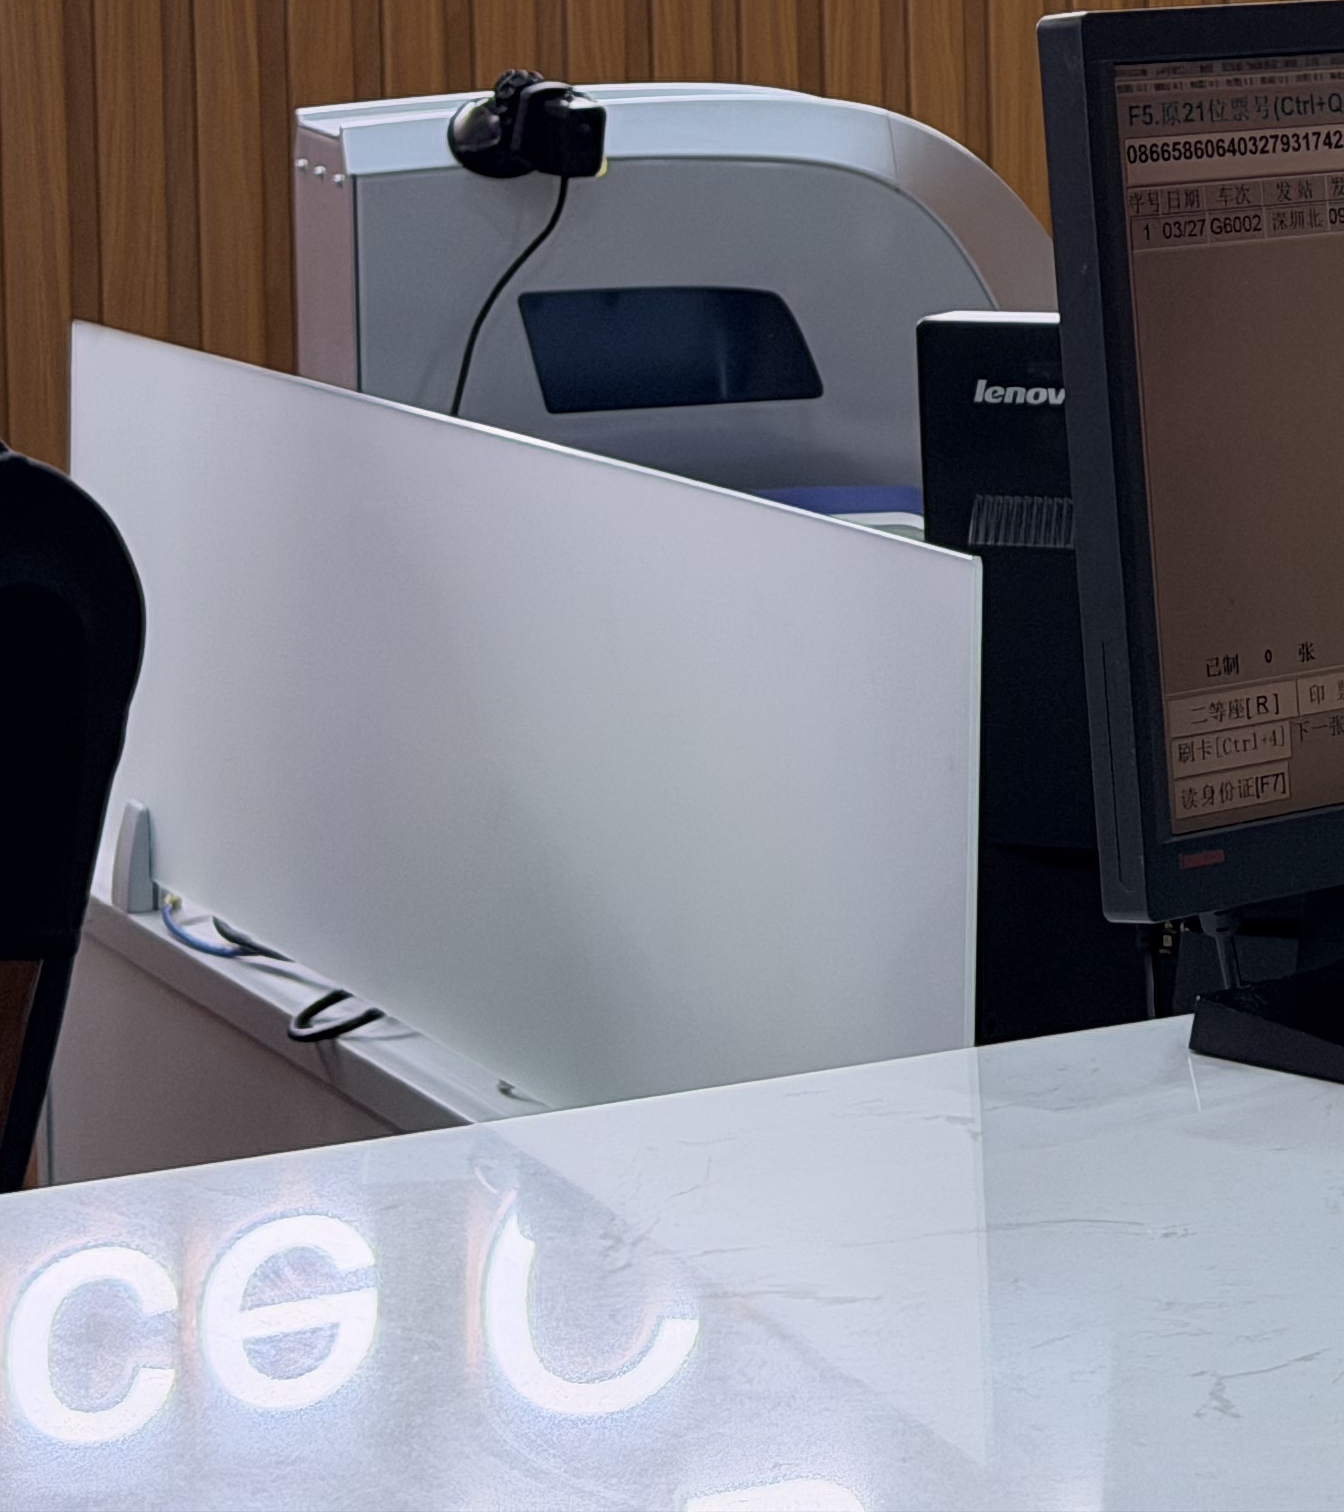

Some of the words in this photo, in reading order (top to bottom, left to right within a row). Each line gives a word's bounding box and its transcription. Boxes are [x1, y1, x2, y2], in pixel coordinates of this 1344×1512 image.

[1143, 224, 1151, 241] 1
[1162, 218, 1206, 240] 03/27
[1209, 214, 1263, 236] G6002
[973, 379, 1066, 405] lenov
[1298, 642, 1317, 664] 张
